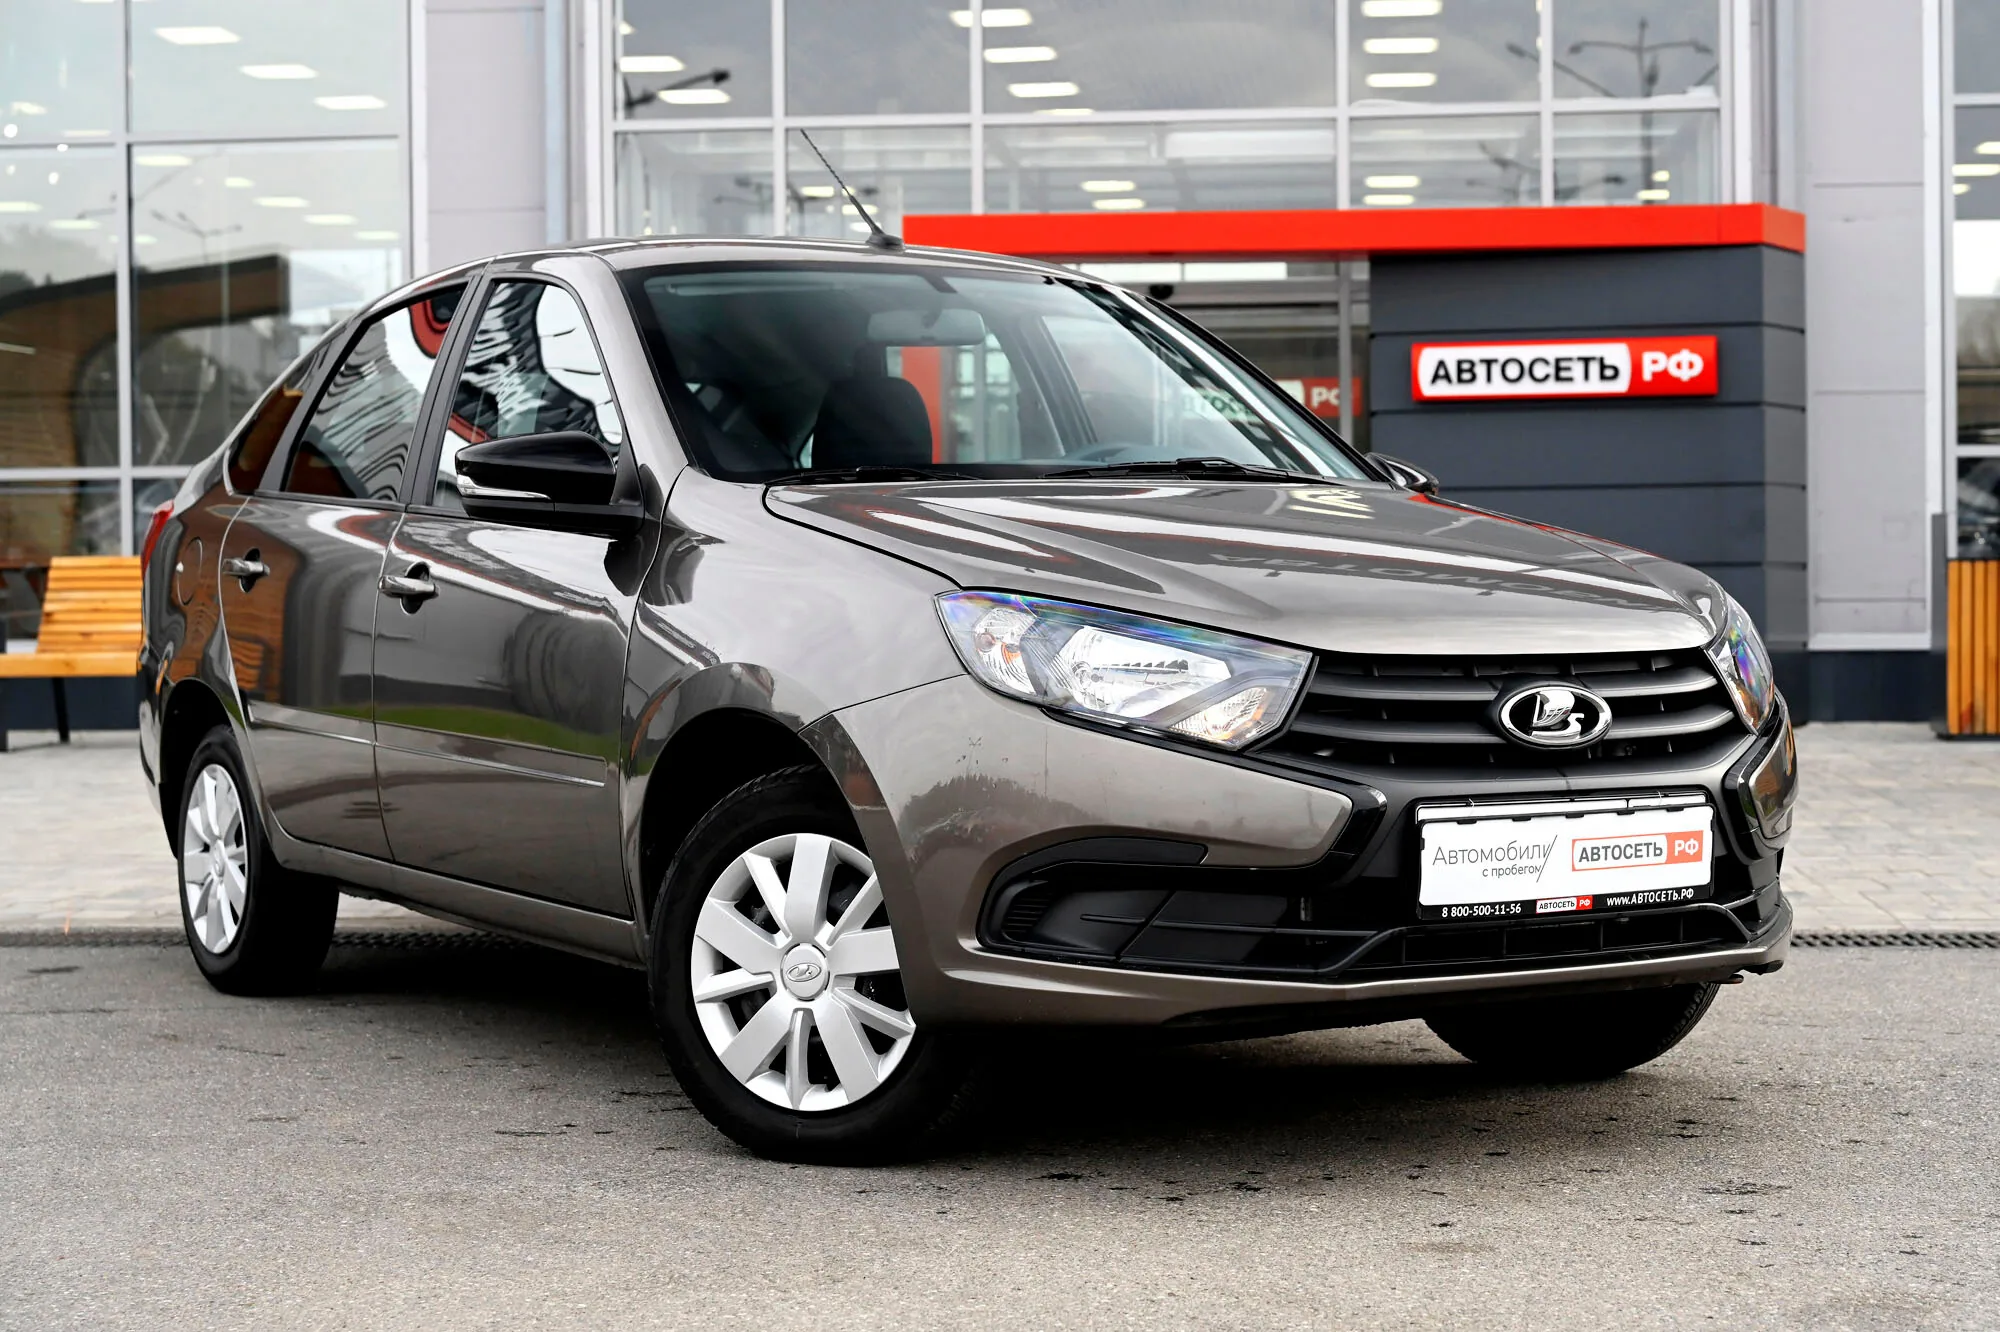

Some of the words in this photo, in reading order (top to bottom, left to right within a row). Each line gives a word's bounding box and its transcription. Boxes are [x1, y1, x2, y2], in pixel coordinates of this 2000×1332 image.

[1431, 356, 1620, 384] АВТОСЕТЬ
[1641, 348, 1704, 382] РФ
[1432, 840, 1551, 866] Автомобили
[1578, 842, 1663, 862] АВТОСЕТЬ
[1674, 838, 1699, 856] РФ
[1482, 868, 1489, 877] с
[1491, 864, 1541, 878] пробегом
[1538, 900, 1576, 910] АВТОСЕТЬ
[1579, 898, 1591, 907] РФ
[1606, 888, 1694, 906] www.АВТОСЕТЬ.РФ
[1441, 907, 1449, 918] 8
[1450, 903, 1521, 917] 800-500-11-56
